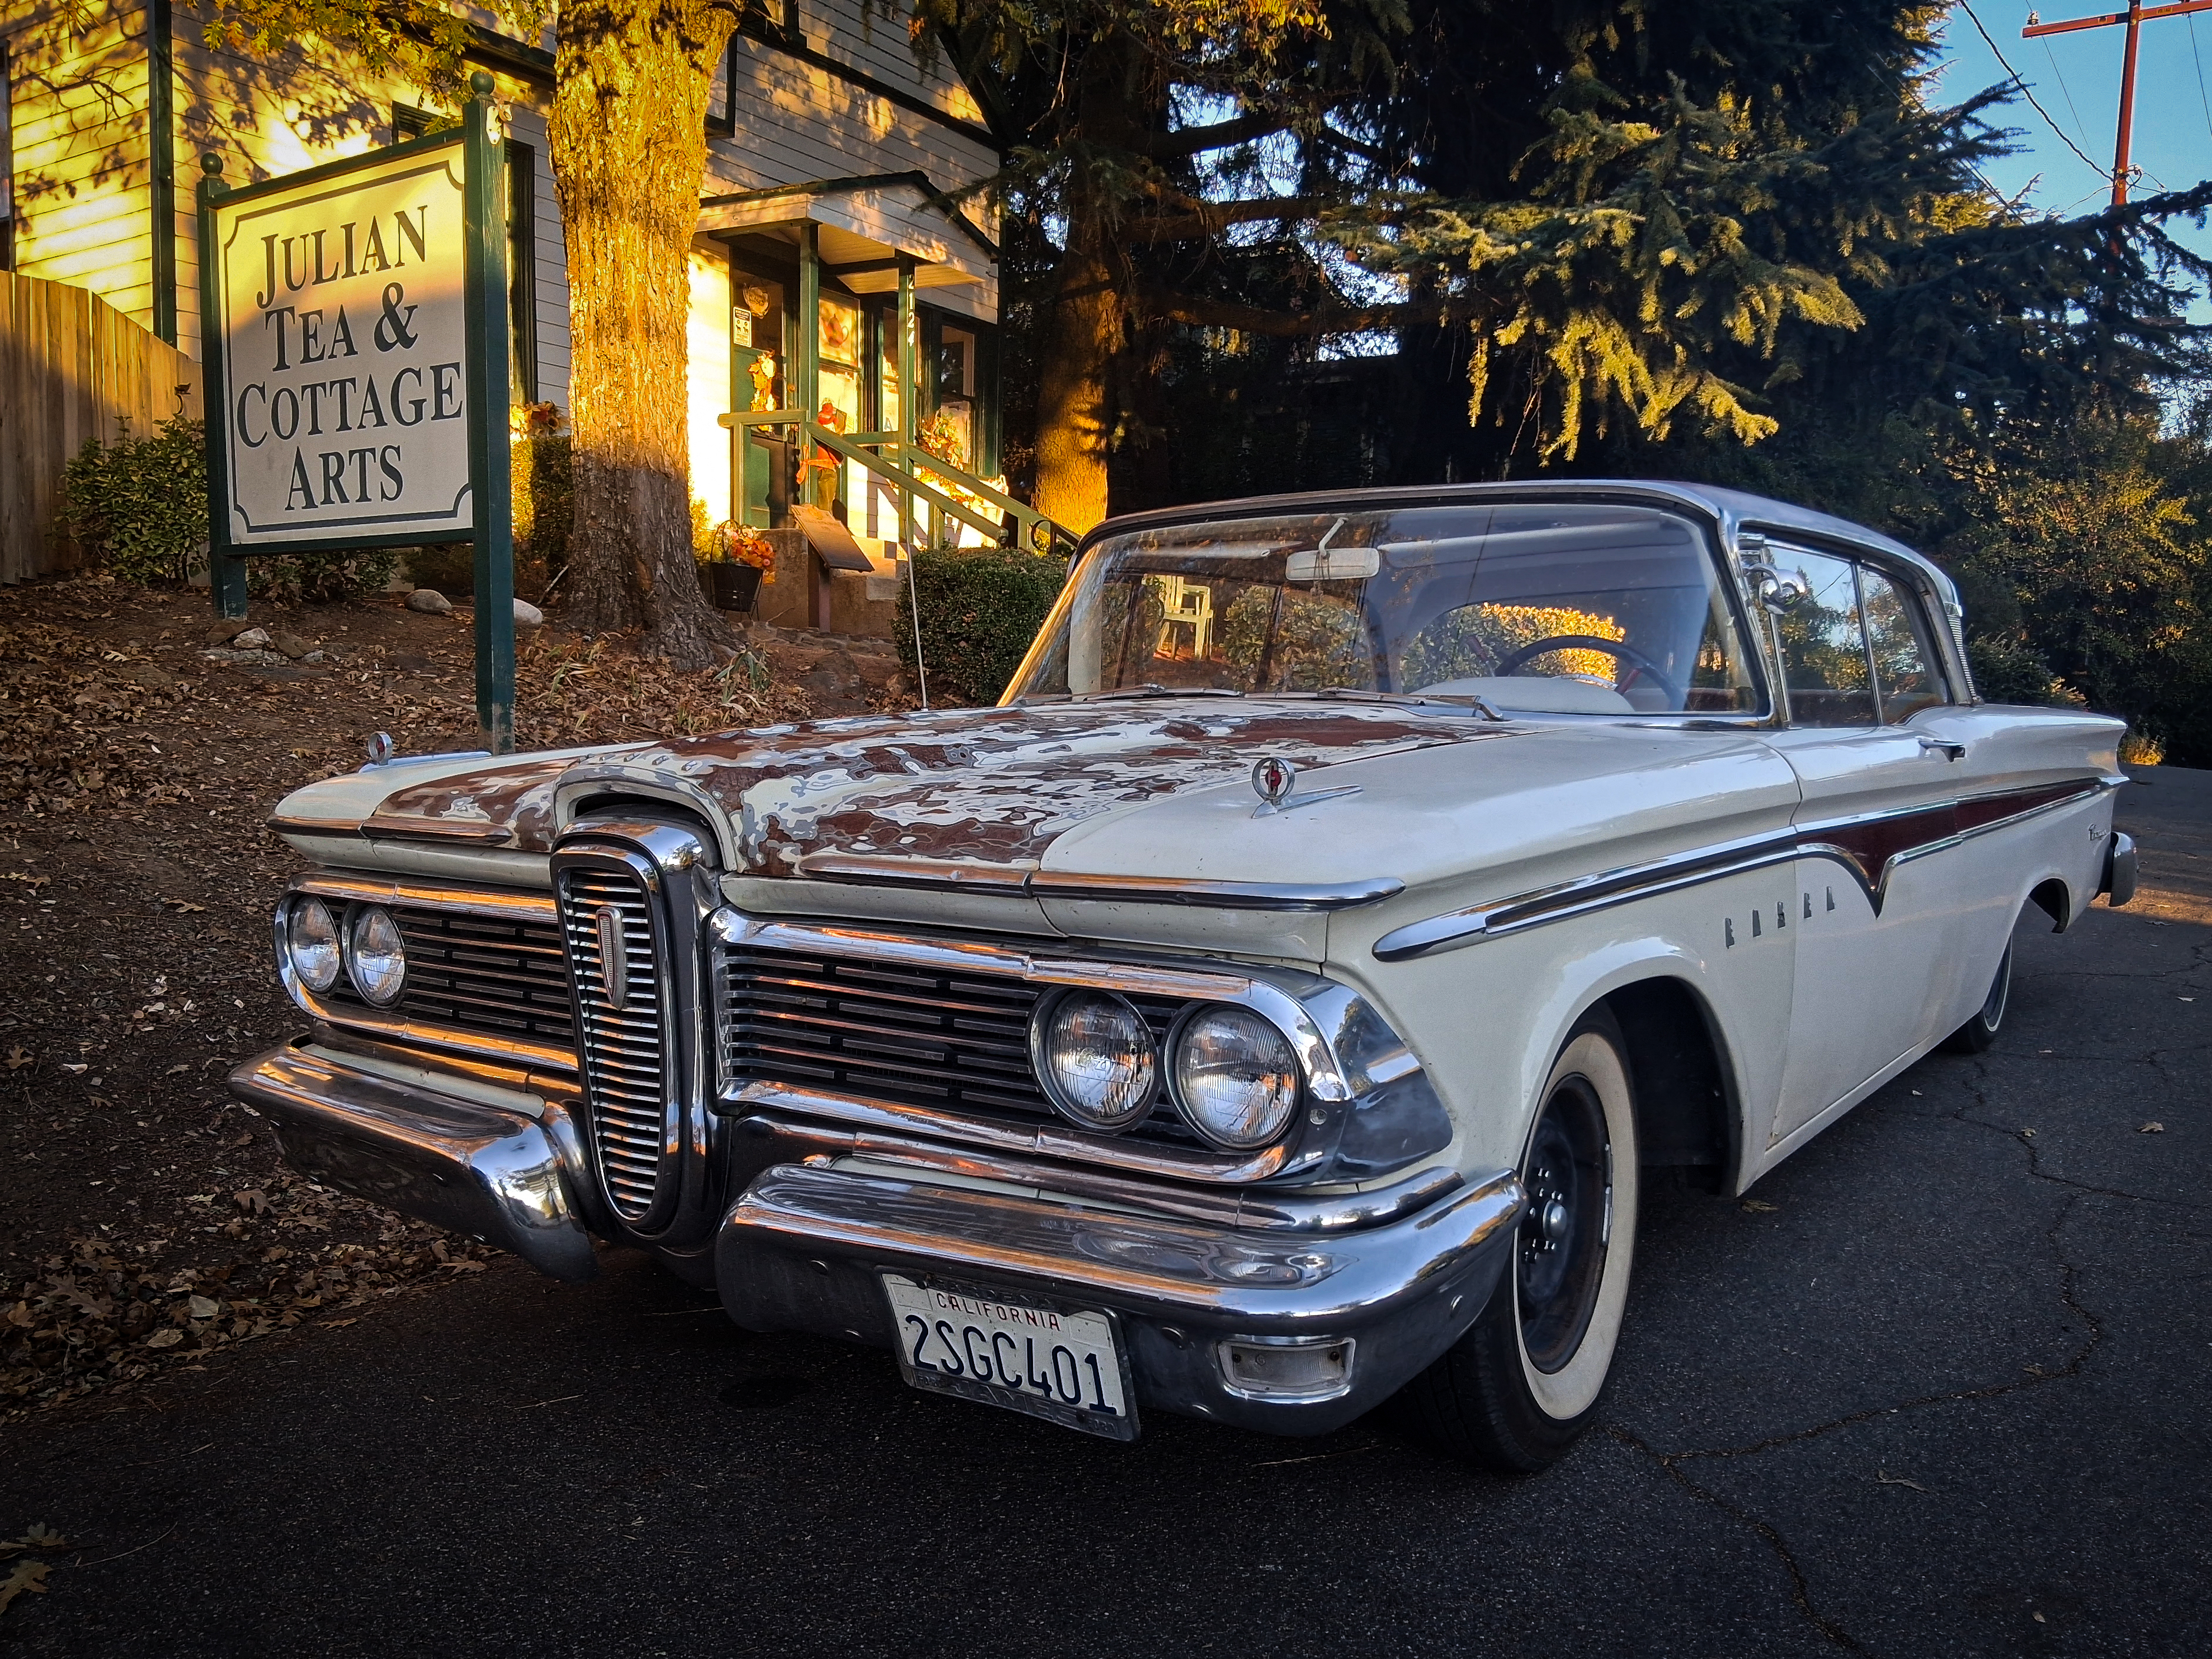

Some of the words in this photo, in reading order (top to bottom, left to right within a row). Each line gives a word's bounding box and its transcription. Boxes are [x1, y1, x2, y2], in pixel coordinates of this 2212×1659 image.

[257, 205, 428, 309] JULIAN
[265, 304, 358, 372] TEA
[373, 282, 419, 352] &
[237, 362, 463, 448] COTTAGE
[285, 445, 403, 511] ARTS
[936, 1293, 1061, 1332] CALIFORNIA
[906, 1314, 1117, 1415] 2SGC401
